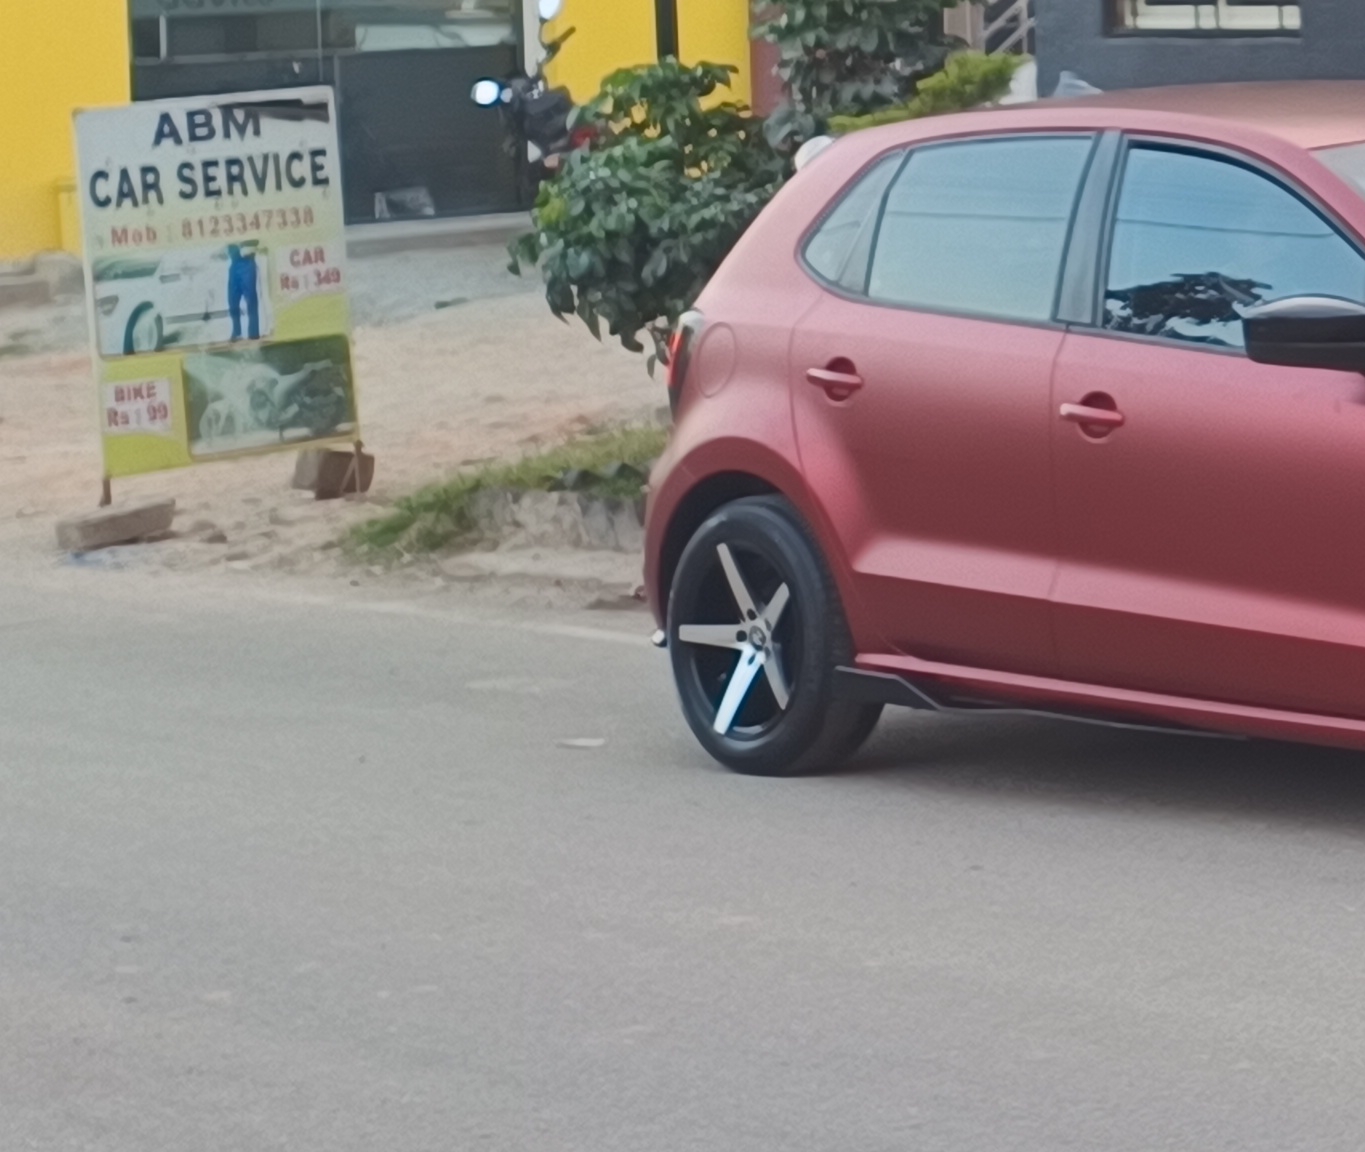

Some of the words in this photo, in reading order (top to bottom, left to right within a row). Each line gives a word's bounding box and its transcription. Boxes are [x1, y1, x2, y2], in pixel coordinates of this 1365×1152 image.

[151, 107, 262, 148] ABM
[89, 165, 165, 208] CAR
[176, 148, 331, 201] SERVICE
[289, 246, 326, 267] CAR
[114, 382, 157, 403] BIKE
